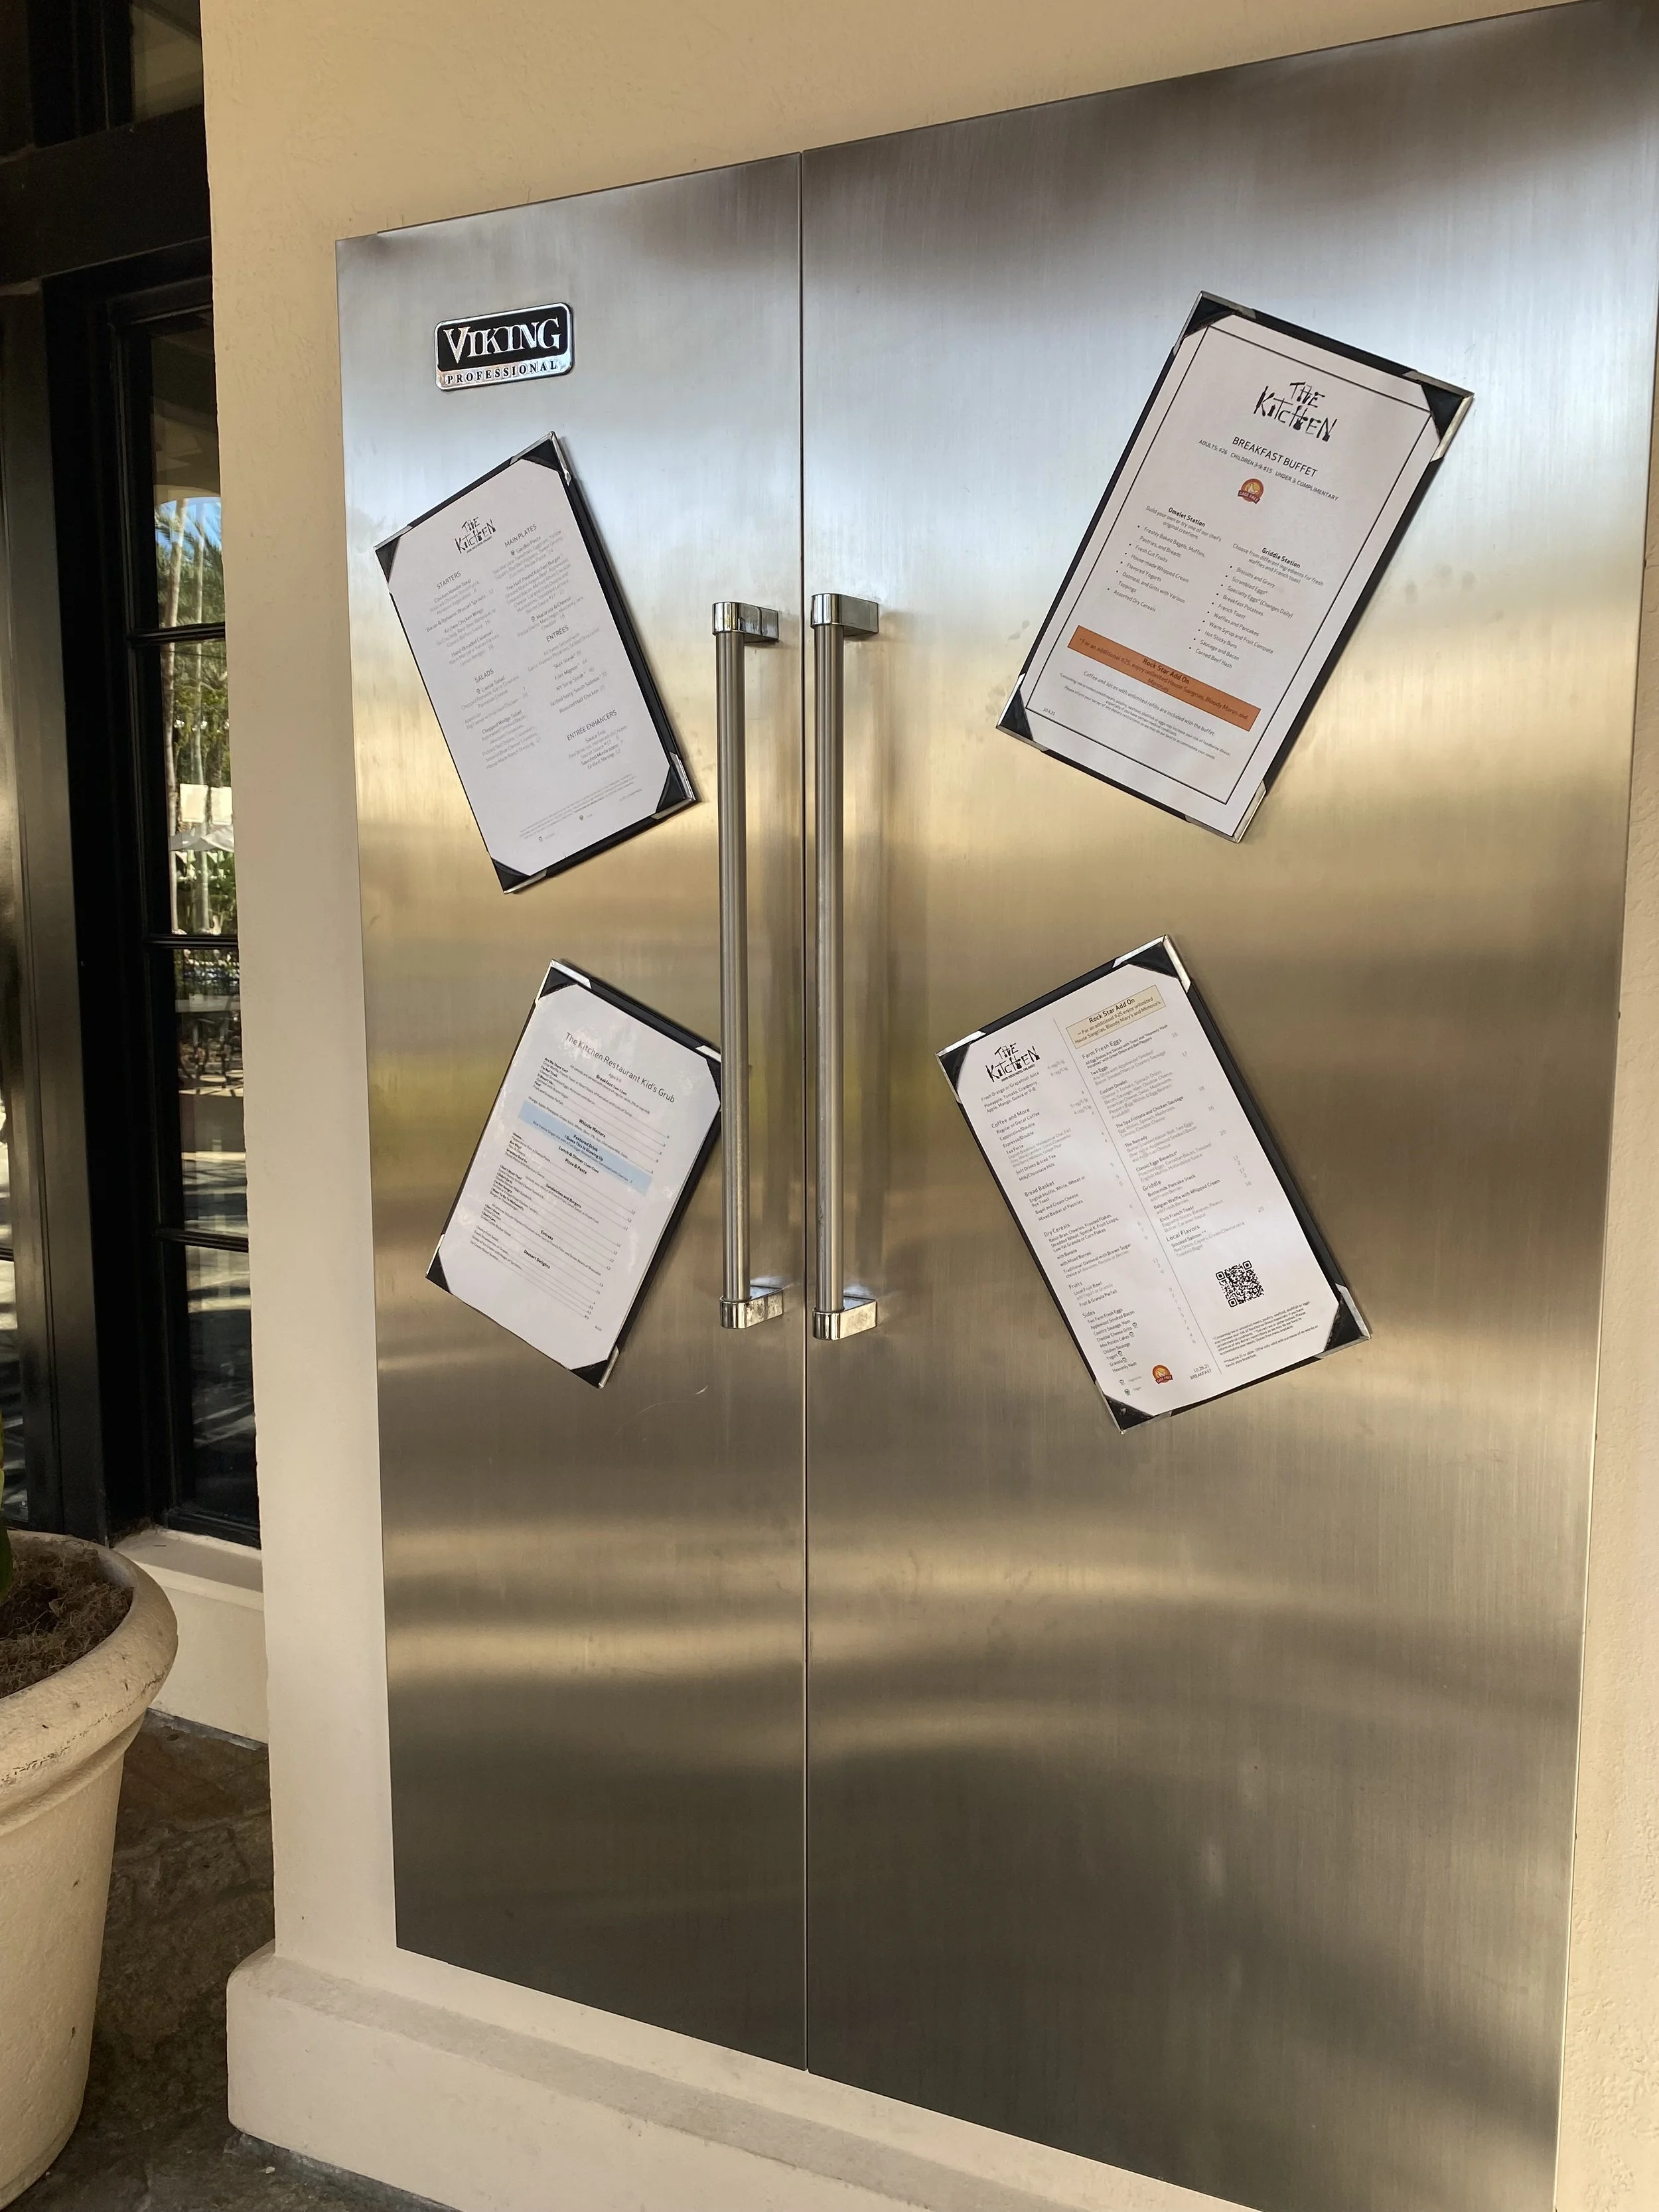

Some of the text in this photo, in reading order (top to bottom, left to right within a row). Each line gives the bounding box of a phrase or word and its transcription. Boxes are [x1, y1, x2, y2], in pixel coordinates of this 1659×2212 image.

[443, 317, 561, 364] VIKING
[447, 360, 557, 384] PROFESSIONAL
[1289, 381, 1326, 408] THE
[1253, 385, 1338, 443] KITCHEN
[1232, 436, 1318, 477] BREAKFAST BUFFET
[1198, 439, 1218, 451] ADULTS:
[1230, 452, 1255, 466] CHILDREN
[1253, 461, 1263, 470] 3-9:
[1275, 471, 1293, 482] UNDER
[1296, 480, 1339, 501] COMPLIMENTARY
[461, 516, 480, 532] THE
[1168, 507, 1206, 528] Omelet Station
[454, 518, 496, 554] KITCHEN
[504, 523, 537, 548] MAIN PLATES
[1135, 544, 1148, 553] Fresh
[1155, 553, 1168, 563] Fruits
[1262, 548, 1301, 569] Griddle Station
[436, 570, 461, 590] STARTERS
[1126, 562, 1162, 582] Flavored Yogurts
[1157, 565, 1176, 577] Whipped
[1175, 573, 1189, 583] Cream
[1236, 567, 1254, 579] Biscuits
[1262, 578, 1275, 589] Gravy
[1118, 580, 1137, 593] Toppings
[1149, 583, 1160, 592] Grits
[1169, 592, 1185, 604] Various
[1231, 576, 1256, 590] Scrambled
[1113, 589, 1156, 613] Assorted Dry Cereals
[1218, 603, 1246, 619] French Toast
[1222, 594, 1264, 617] Breakfast Potatoes
[545, 625, 569, 642] ENTRÉES
[1213, 612, 1231, 624] Waffles
[1238, 623, 1260, 637] Pancakes
[1208, 621, 1222, 631] Warm
[1221, 627, 1235, 637] Syrup
[1242, 636, 1254, 646] Fruit
[1254, 641, 1274, 654] Compote
[1212, 634, 1227, 645] Sticky
[1226, 640, 1238, 649] Buns
[1195, 648, 1232, 669] Corned Beef Hash
[1199, 639, 1218, 652] Sausage
[1225, 651, 1240, 661] Bacon
[474, 668, 494, 684] SALADS
[1142, 658, 1192, 685] Rock Star Add On
[567, 709, 617, 741] ENTRÉE ENHANCERS
[1088, 1013, 1103, 1024] Rock
[1102, 1008, 1115, 1017] Star
[1115, 1001, 1127, 1011] Add
[994, 1042, 1019, 1060] THE
[1082, 1038, 1122, 1060] Farm Fresh Eggs
[565, 1031, 675, 1103] The Kitchen Restaurant Kid's Grub
[985, 1045, 1041, 1083] KITCHEN
[595, 1074, 613, 1087] Breakfast
[579, 1118, 606, 1138] Whistle Wetters
[991, 1118, 1008, 1129] Coffee
[1016, 1108, 1030, 1117] More
[995, 1126, 1011, 1135] Regular
[1014, 1117, 1027, 1126] Decaf
[1026, 1112, 1040, 1120] Coffee
[573, 1134, 598, 1152] Featured Drink
[558, 1145, 569, 1155] Lunch
[572, 1153, 584, 1163] Dinner
[564, 1157, 575, 1167] Pizza
[577, 1165, 587, 1175] Pasta
[545, 1183, 563, 1197] Sandwiches
[569, 1198, 582, 1209] Burgers
[1024, 1181, 1055, 1197] Bread Basket
[1142, 1181, 1162, 1191] Griddle
[1035, 1207, 1046, 1215] Bagel
[1064, 1193, 1079, 1202] Cheese
[1052, 1222, 1070, 1234] Cereals
[1165, 1225, 1200, 1242] Local Flavors
[524, 1249, 550, 1269] Dessert Delights
[1068, 1282, 1083, 1290] Fruits
[1082, 1310, 1096, 1319] Sides
[1189, 1368, 1212, 1380] BREAKFAST
